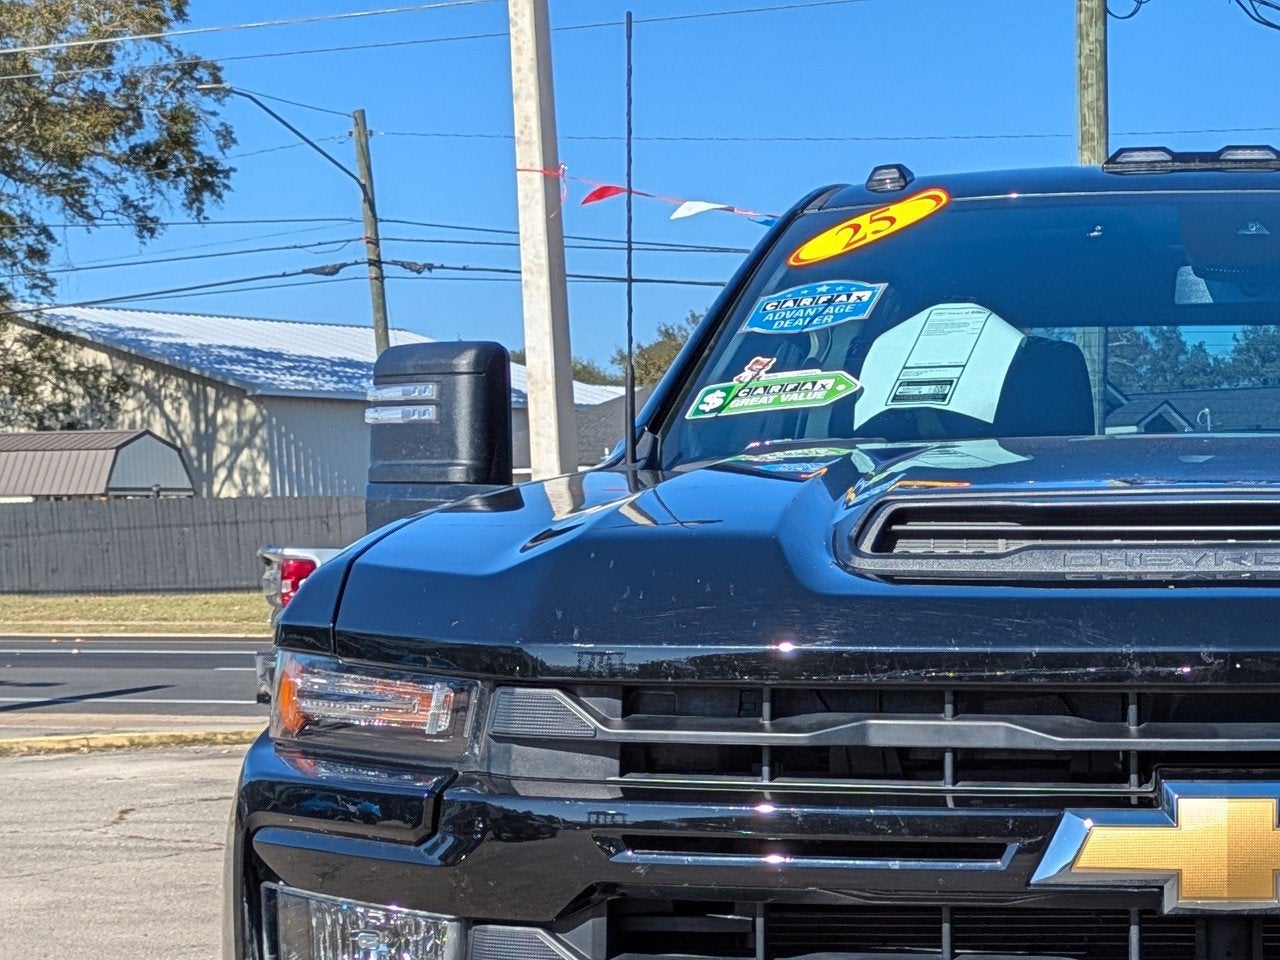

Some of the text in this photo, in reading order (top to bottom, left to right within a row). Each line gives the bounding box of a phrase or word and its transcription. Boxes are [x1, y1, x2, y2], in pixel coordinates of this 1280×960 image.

[835, 208, 897, 250] 25
[763, 291, 871, 312] CARFAX
[736, 380, 835, 397] CARFAX
[729, 390, 828, 409] GREAT VALUE
